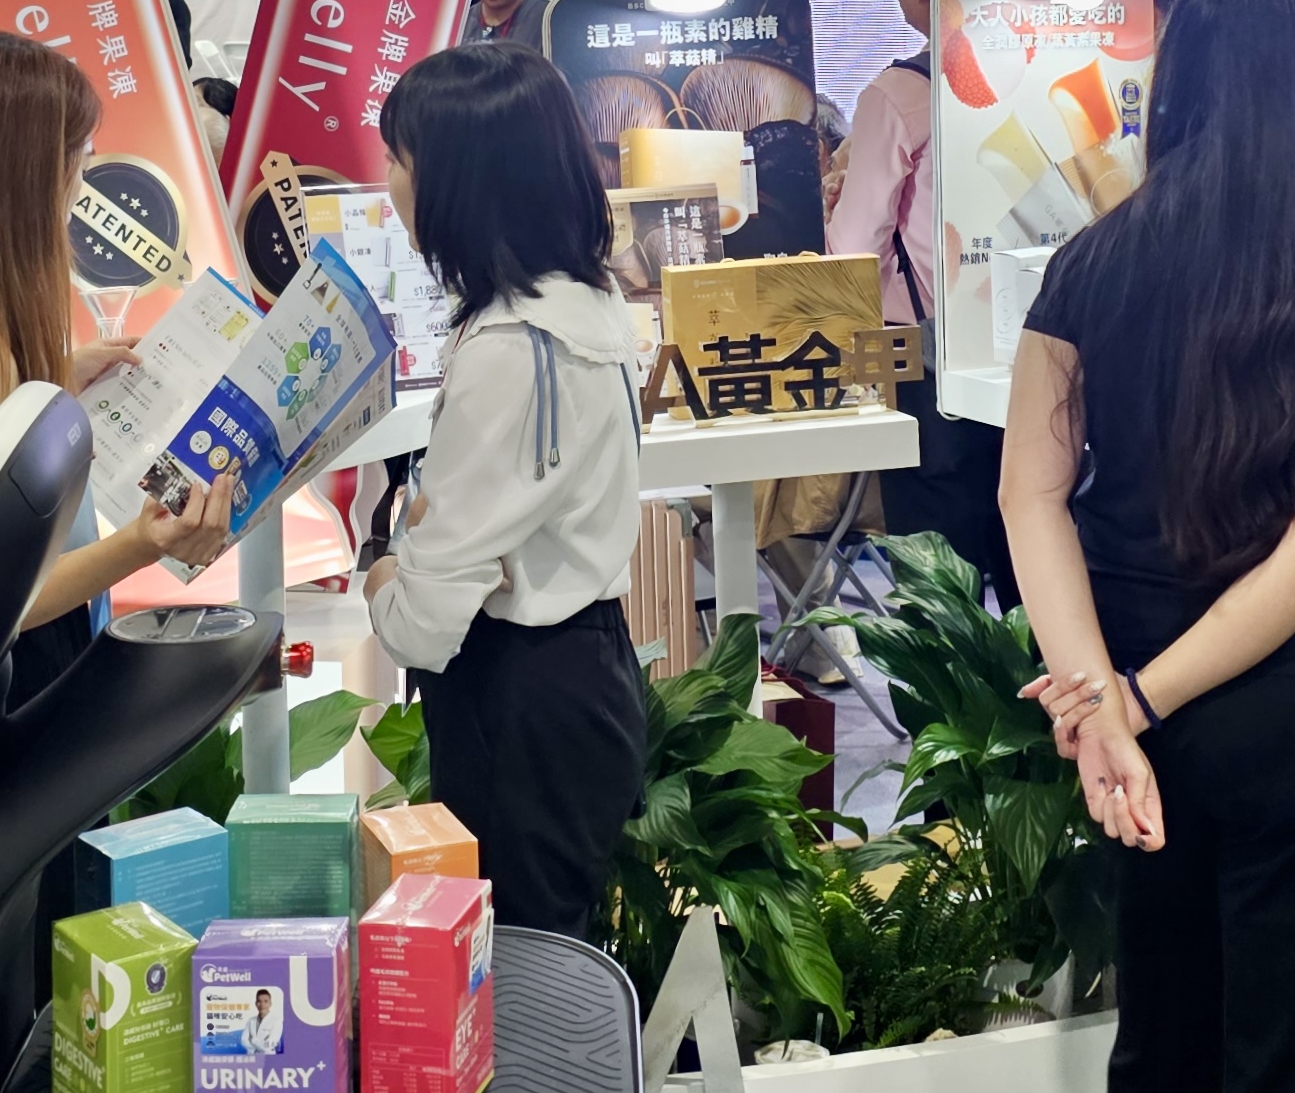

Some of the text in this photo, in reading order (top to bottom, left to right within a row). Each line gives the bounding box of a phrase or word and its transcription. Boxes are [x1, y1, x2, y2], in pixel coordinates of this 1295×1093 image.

[586, 14, 779, 49] 這是一瓶素的雞精
[75, 194, 173, 275] ATENTED
[971, 236, 993, 250] 年度
[213, 971, 252, 983] PetWell
[289, 955, 336, 1027] U
